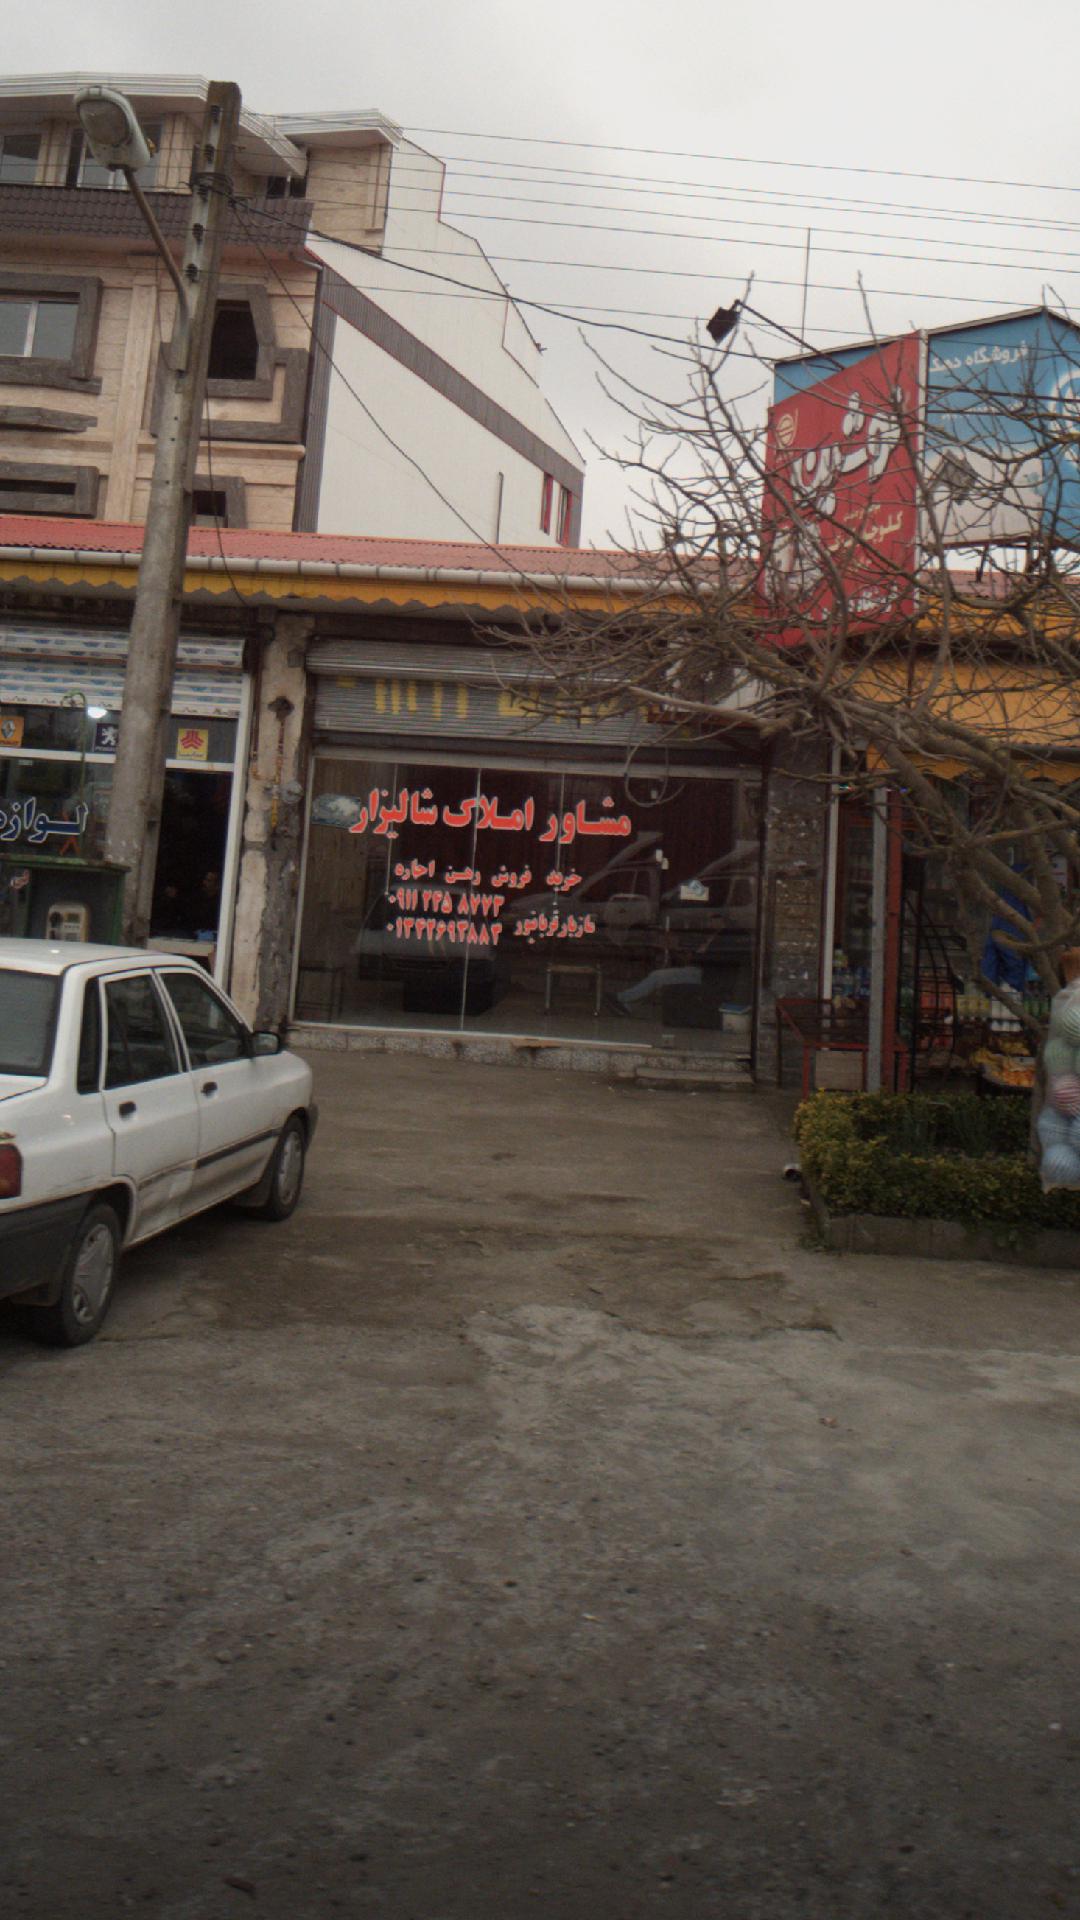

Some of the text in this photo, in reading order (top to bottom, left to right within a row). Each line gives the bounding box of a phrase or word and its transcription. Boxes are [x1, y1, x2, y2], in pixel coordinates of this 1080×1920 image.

[348, 787, 631, 844] مشاور املاک شالیزار
[394, 858, 582, 891] خرید فروش رهن اجاره
[388, 887, 418, 911] ۰۹۱۱
[557, 913, 596, 938] مازیار
